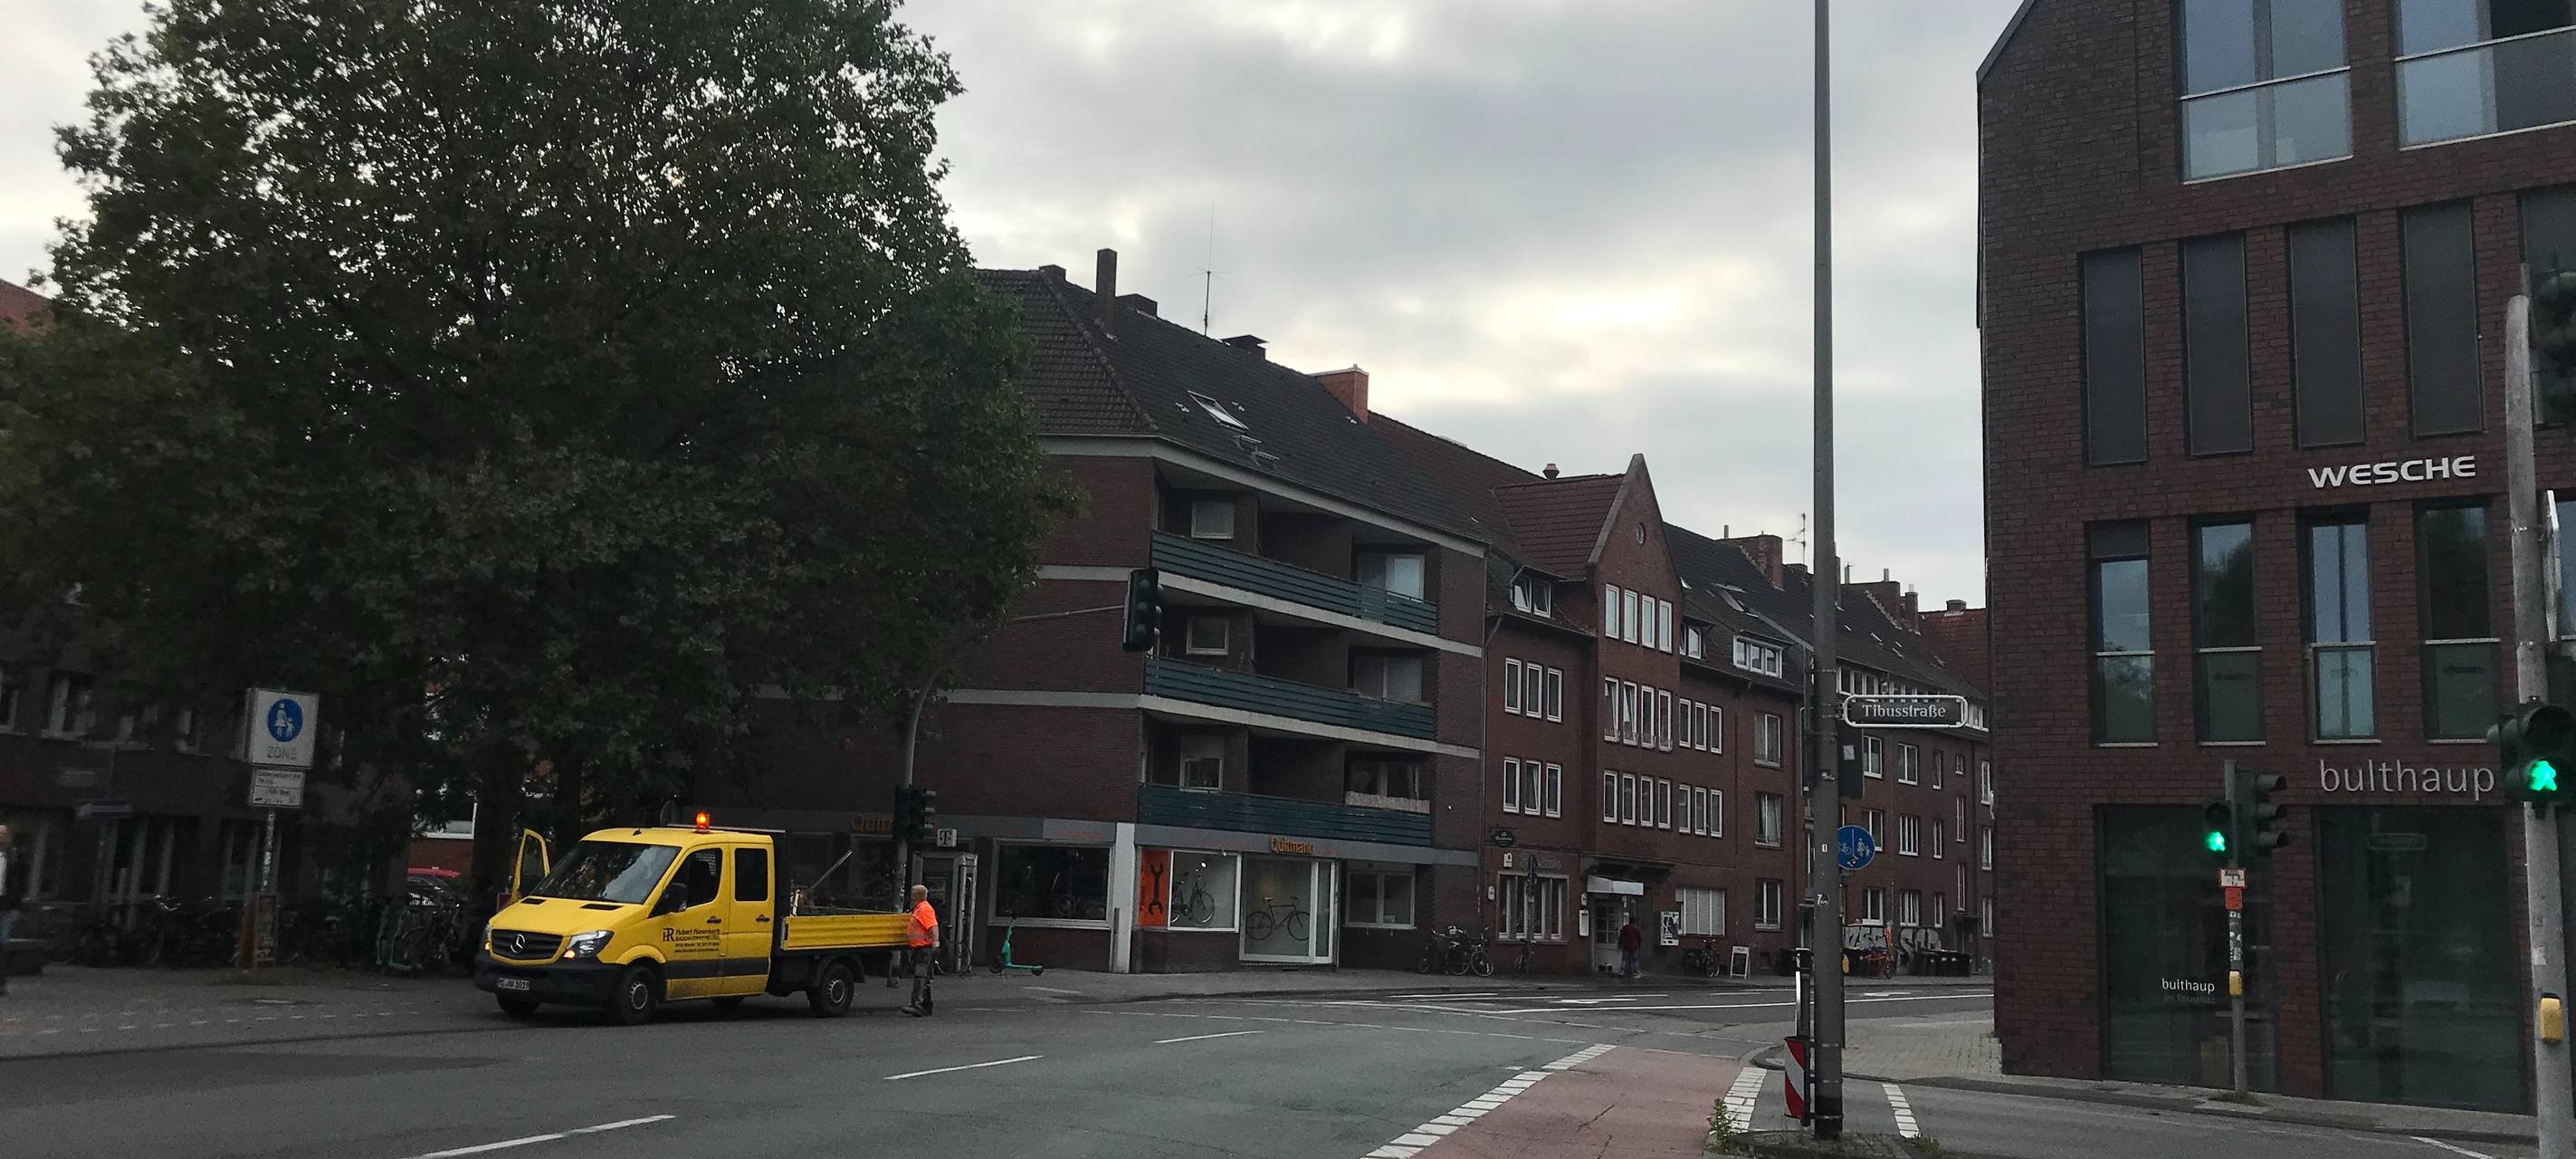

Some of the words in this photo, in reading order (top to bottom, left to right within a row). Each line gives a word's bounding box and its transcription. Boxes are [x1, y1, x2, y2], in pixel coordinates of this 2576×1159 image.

[2307, 455, 2476, 489] WESCHE
[1862, 704, 1946, 718] Tibusstraße
[266, 745, 298, 760] ZONE
[2319, 758, 2495, 801] bulthaup
[939, 829, 952, 846] T
[1270, 836, 1315, 855] Quitmann
[2161, 977, 2215, 995] bulthaup
